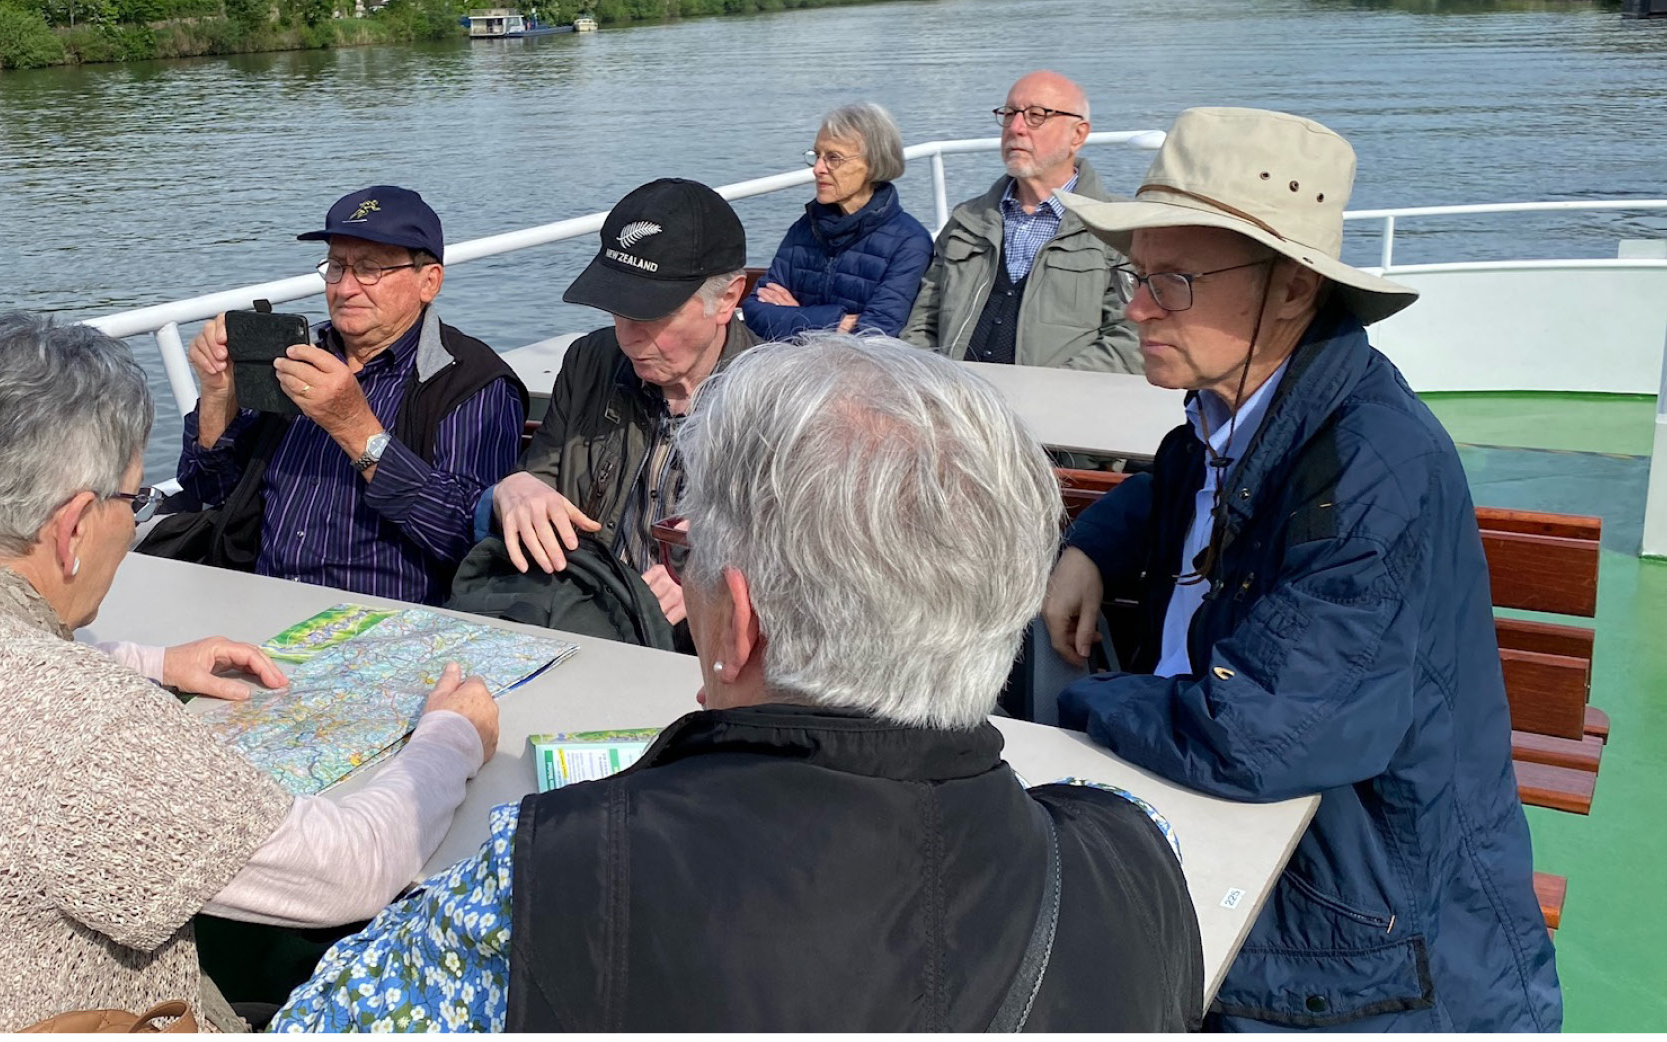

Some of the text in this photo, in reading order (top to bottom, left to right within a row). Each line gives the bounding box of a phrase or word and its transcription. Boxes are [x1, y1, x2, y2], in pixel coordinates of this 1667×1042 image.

[606, 248, 658, 272] NEW ZEALAND
[1225, 890, 1240, 906] 225
